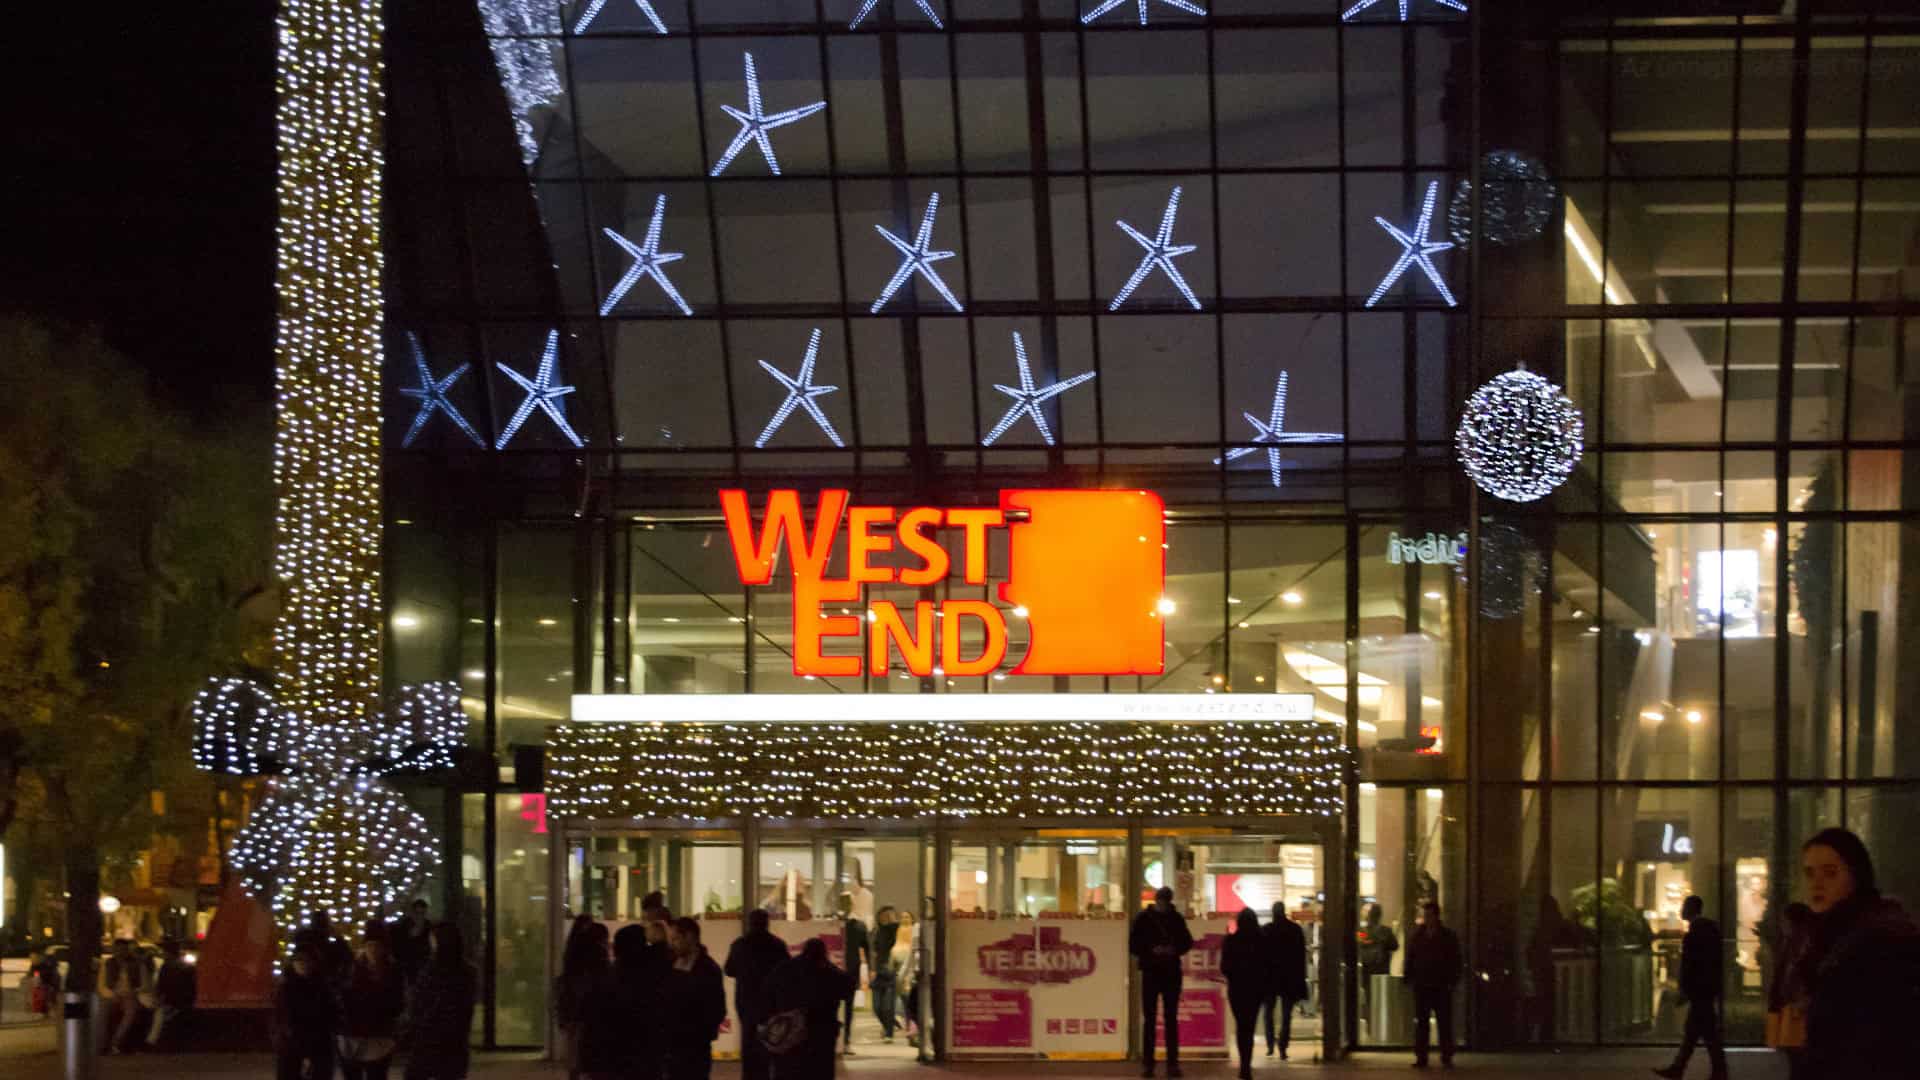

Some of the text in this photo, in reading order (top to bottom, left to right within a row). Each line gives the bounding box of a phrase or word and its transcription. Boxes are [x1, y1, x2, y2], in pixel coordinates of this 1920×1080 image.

[718, 488, 1007, 586] WEST
[793, 580, 1009, 677] END
[982, 949, 1089, 971] TELEKOM
